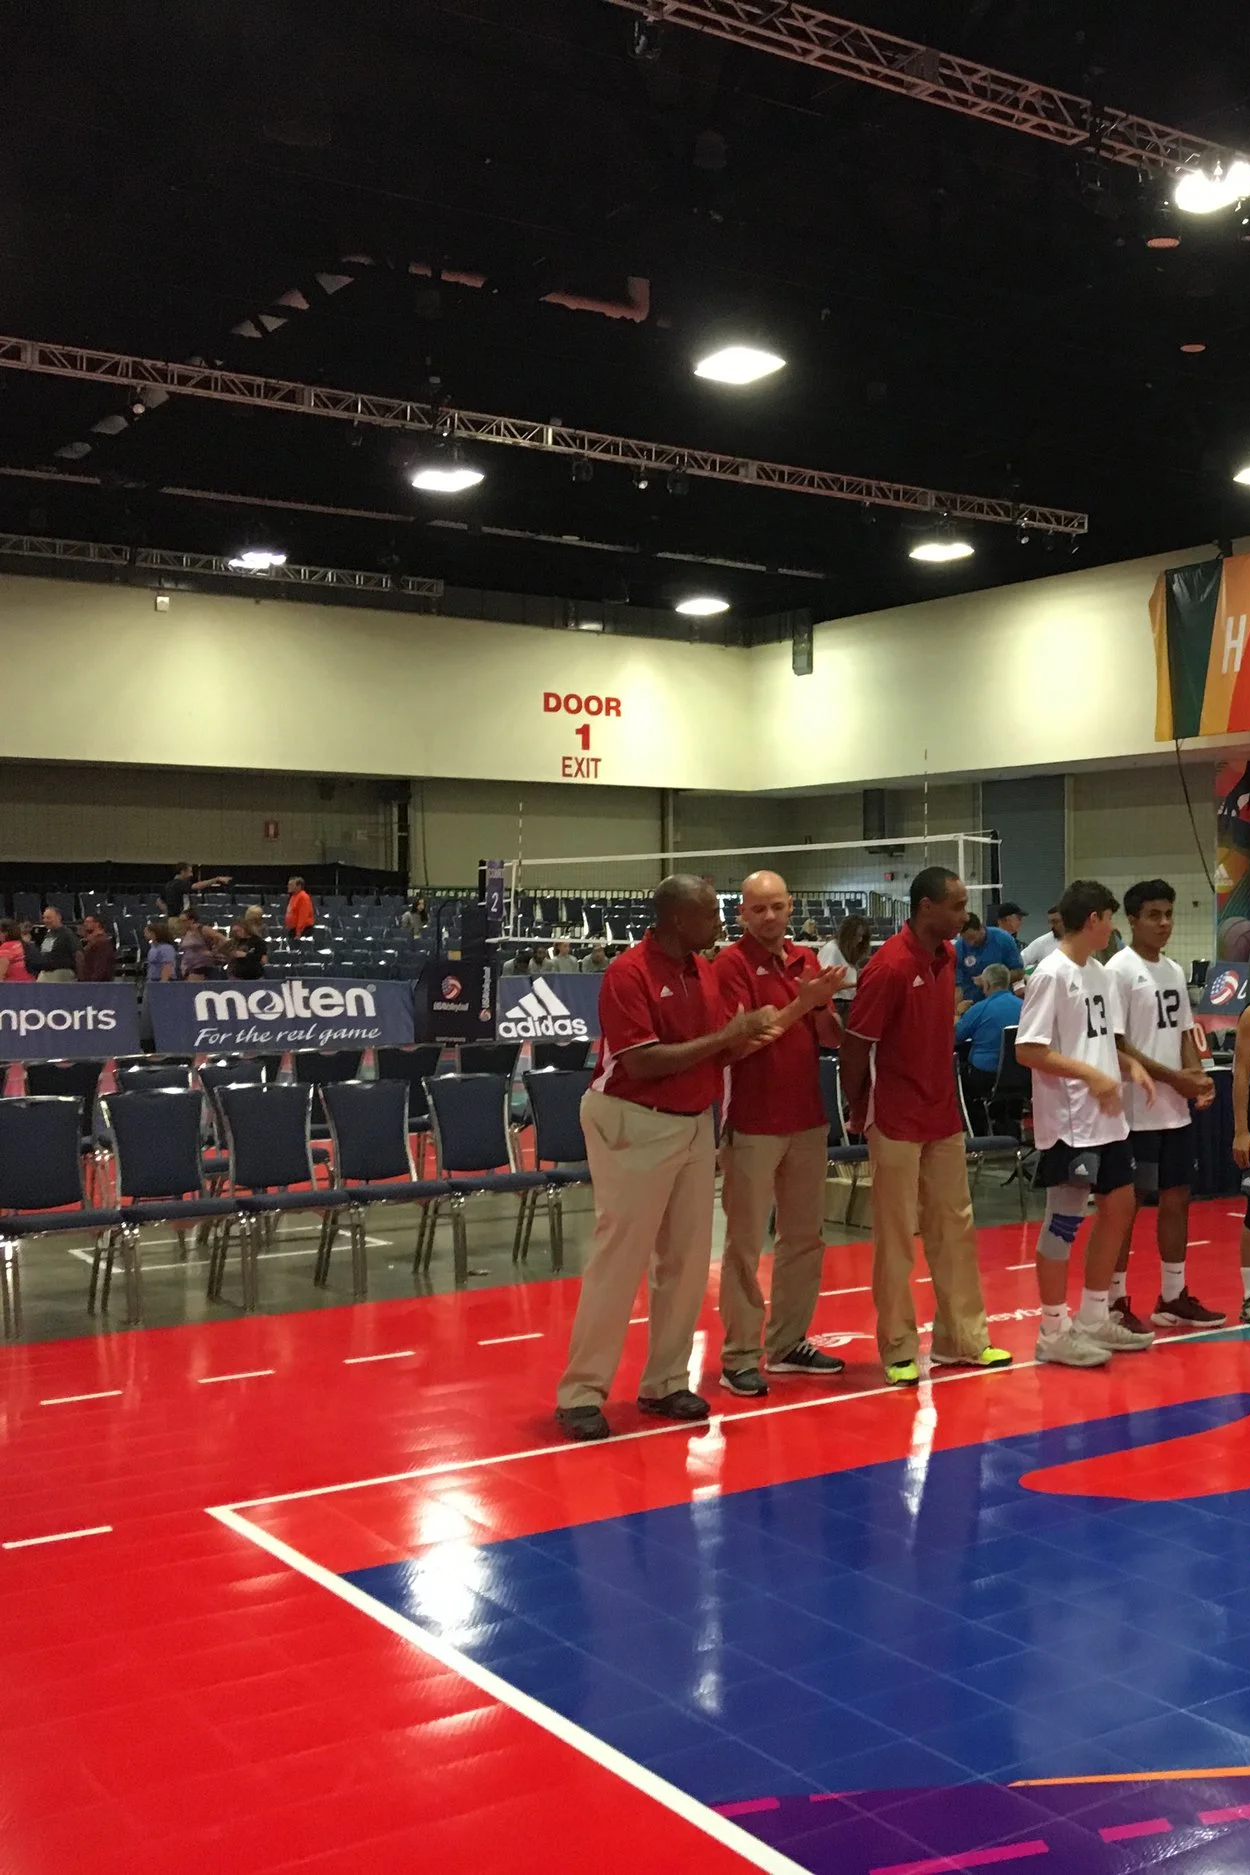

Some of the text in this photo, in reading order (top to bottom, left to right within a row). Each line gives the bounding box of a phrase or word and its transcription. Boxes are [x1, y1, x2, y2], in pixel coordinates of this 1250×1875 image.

[543, 692, 622, 717] DOOR
[575, 723, 591, 751] 1
[562, 756, 602, 778] EXIT
[490, 892, 499, 912] 2
[194, 980, 376, 1021] molten
[1155, 989, 1180, 1029] 12
[499, 1016, 588, 1038] adidas
[1085, 994, 1107, 1038] 13
[194, 1023, 381, 1047] For the real game
